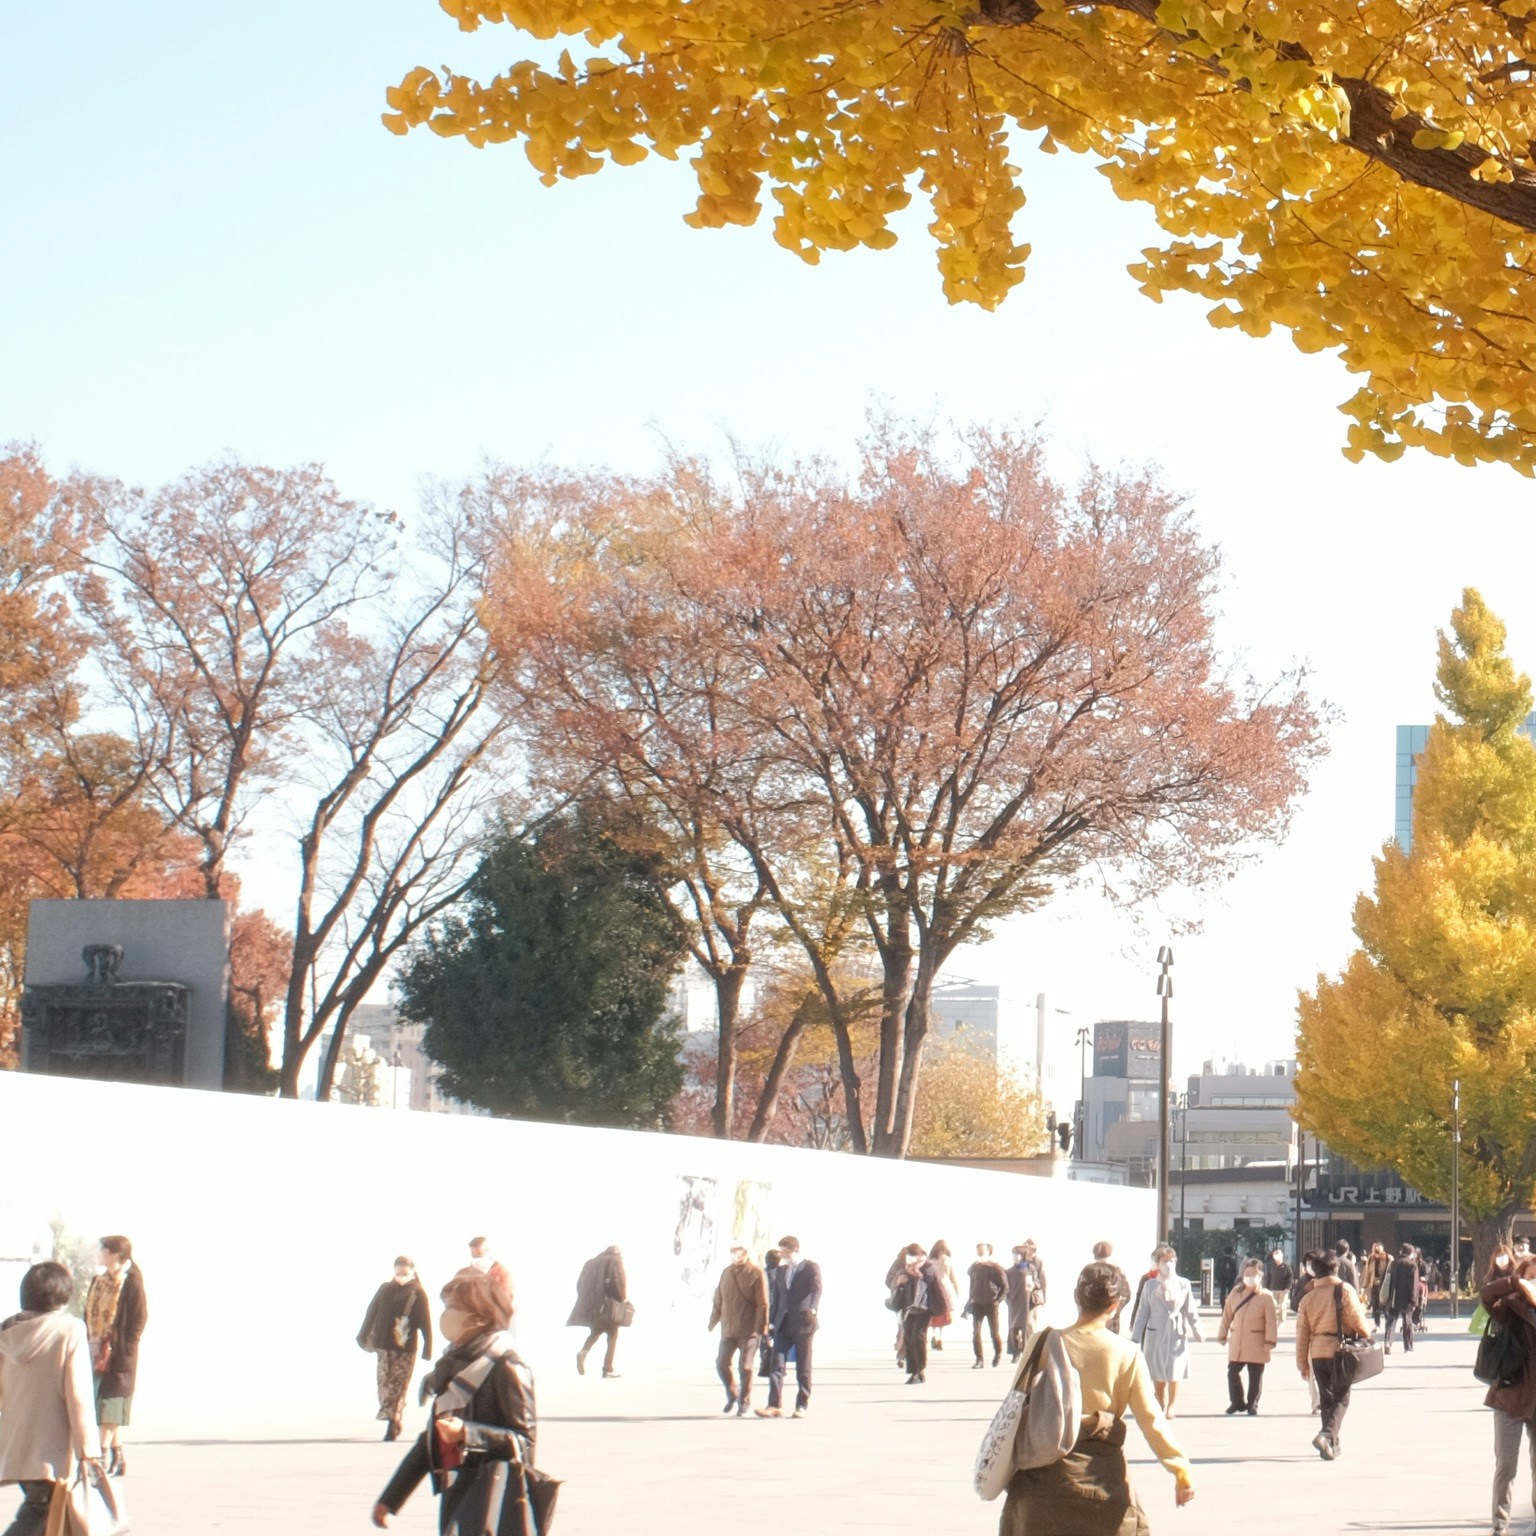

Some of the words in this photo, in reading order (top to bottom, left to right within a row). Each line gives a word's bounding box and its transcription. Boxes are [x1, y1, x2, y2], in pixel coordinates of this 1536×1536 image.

[1329, 1187, 1359, 1203] JR
[1364, 1187, 1443, 1204] 上野駅
